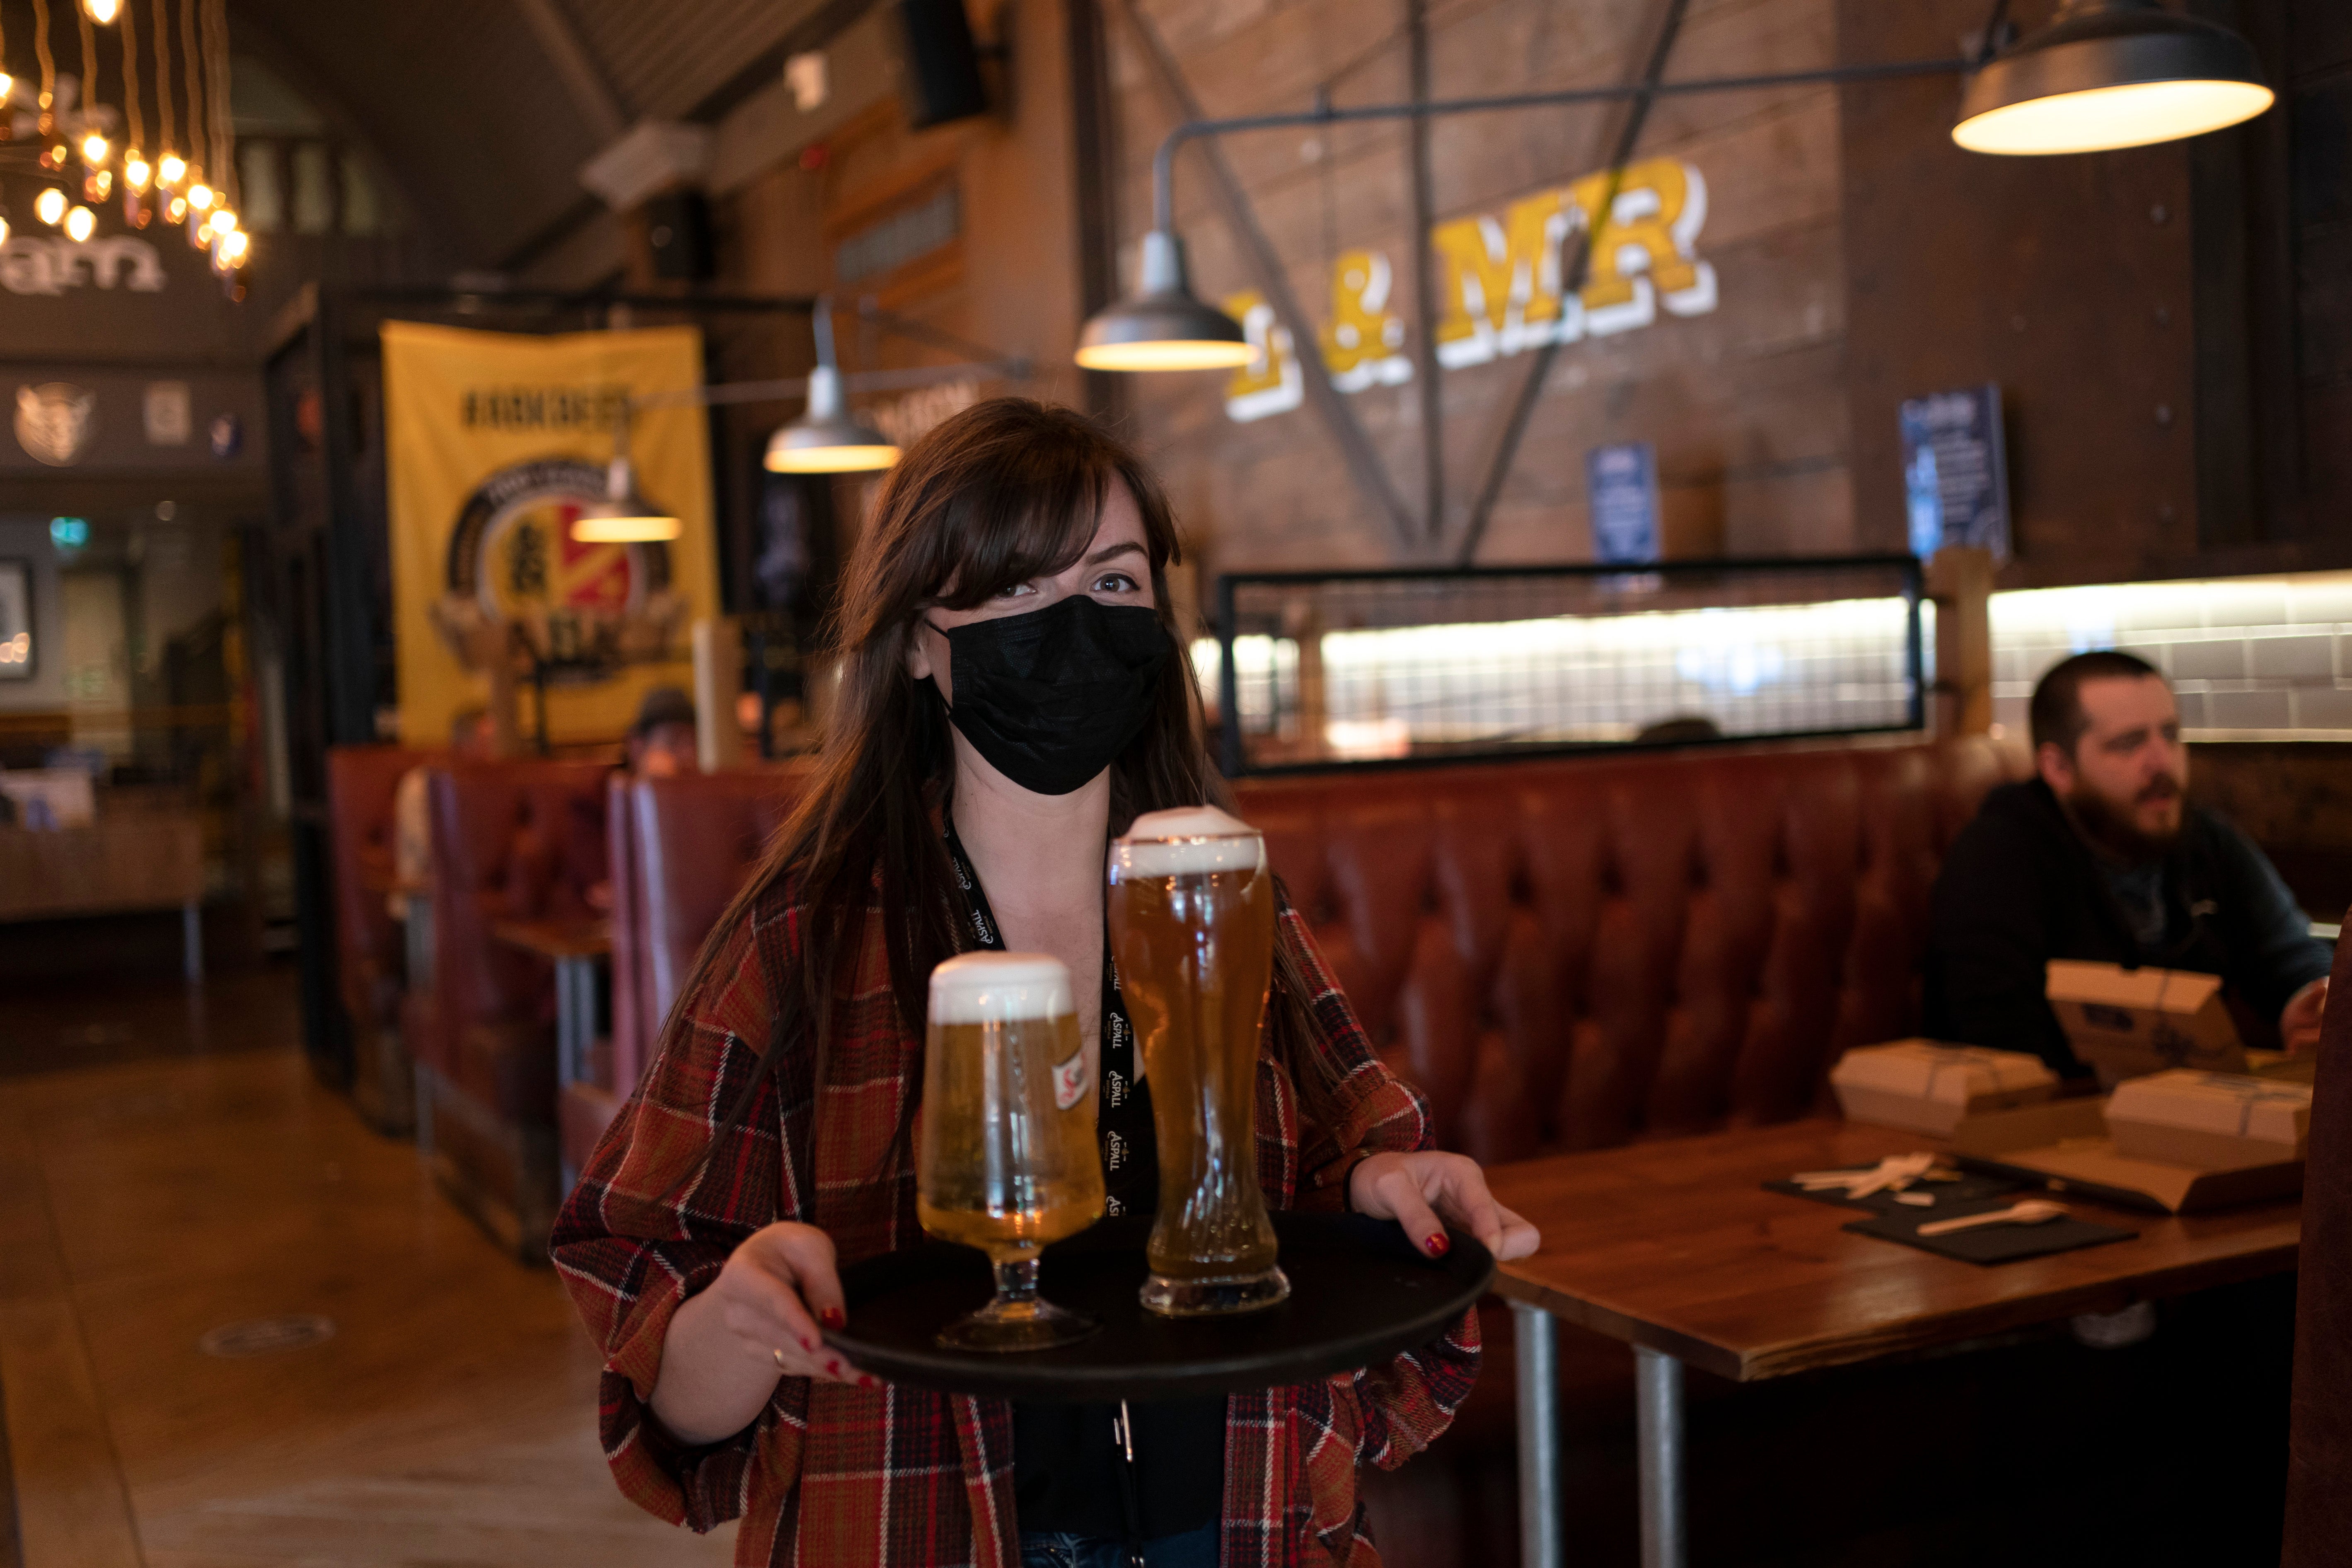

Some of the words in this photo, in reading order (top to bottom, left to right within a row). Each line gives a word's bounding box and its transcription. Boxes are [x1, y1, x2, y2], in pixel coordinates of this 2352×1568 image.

[973, 910, 993, 944] ASPALL
[1110, 1012, 1124, 1049] ASPALL
[1109, 1070, 1123, 1108] ASPALL
[1107, 1131, 1122, 1171] ASPALL
